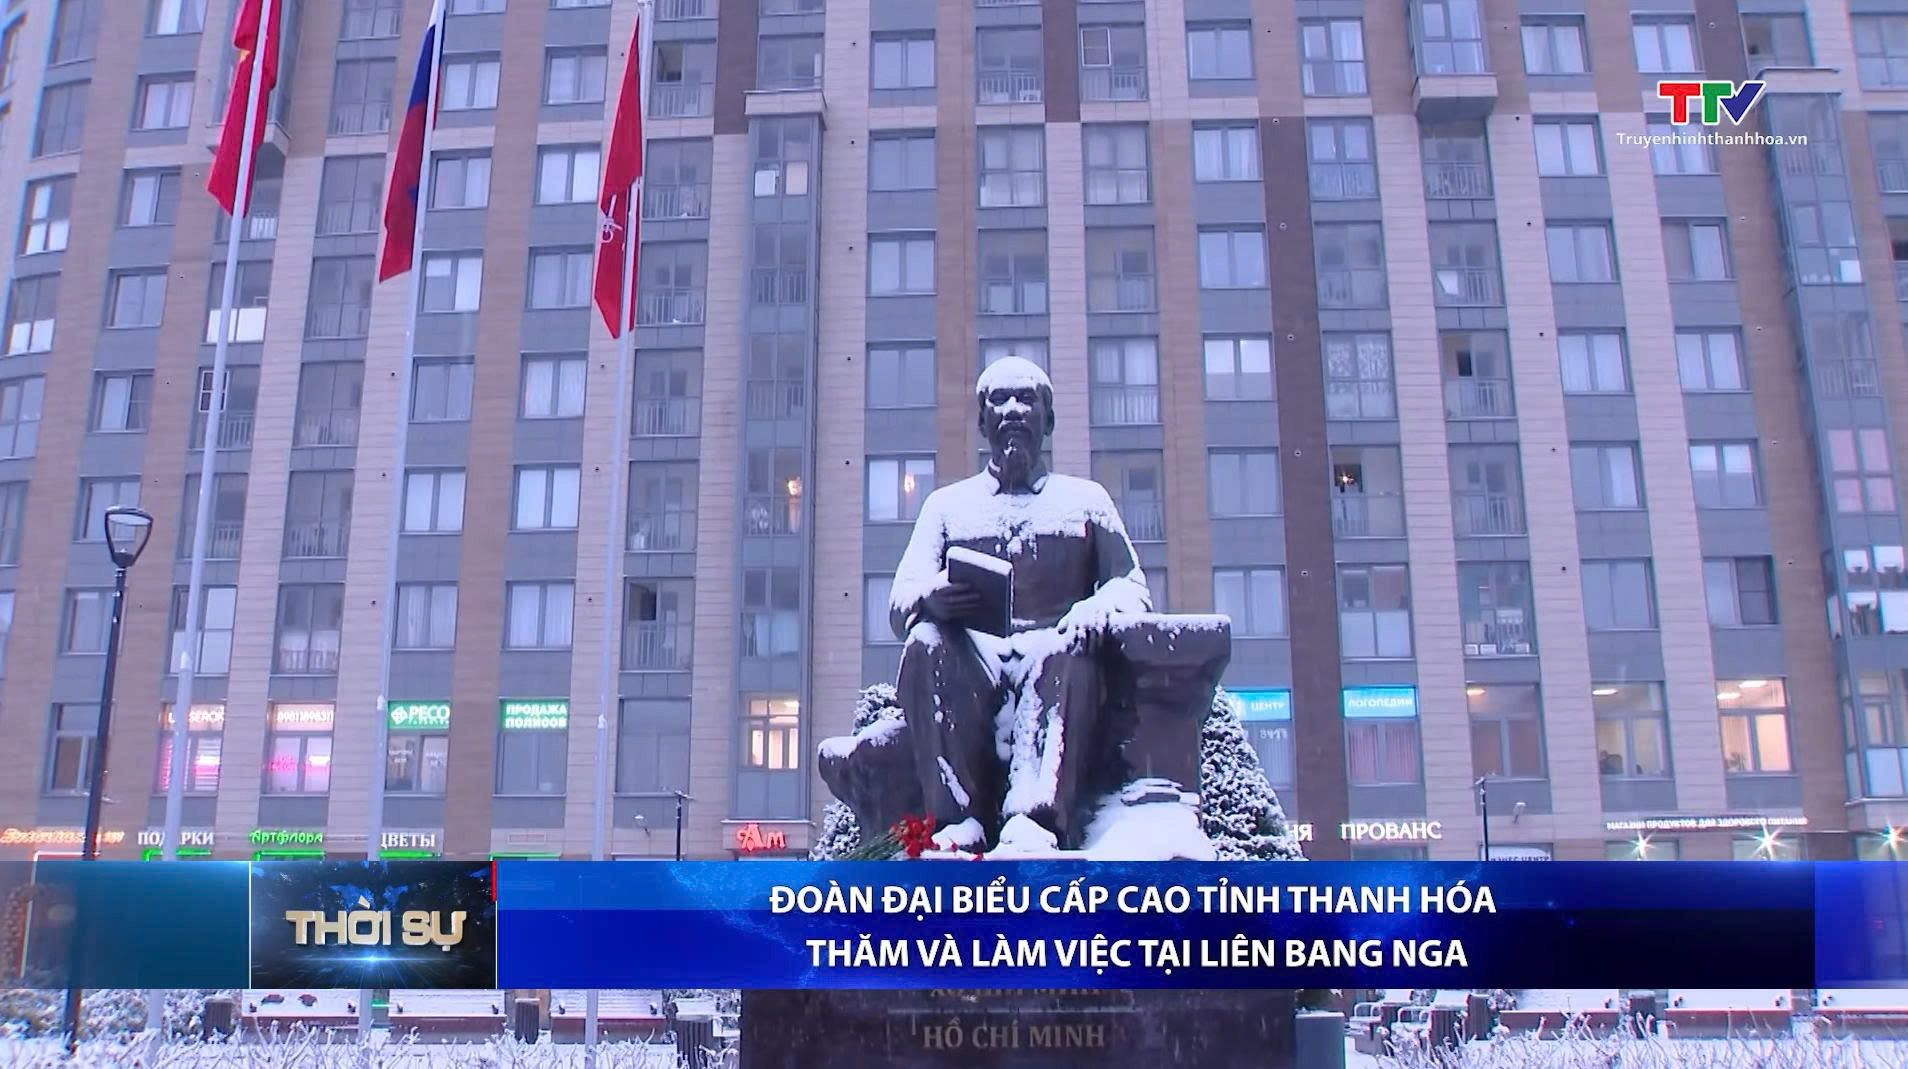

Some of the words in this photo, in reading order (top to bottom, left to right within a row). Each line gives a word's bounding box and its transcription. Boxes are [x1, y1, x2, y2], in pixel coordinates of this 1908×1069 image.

[408, 705, 450, 720] РЕСО
[506, 704, 567, 716] ПРОДАЖА
[505, 717, 567, 728] ПОЛИСОВ
[1341, 822, 1442, 840] ПРОВАНС
[138, 831, 214, 847] ПОРКИ
[924, 1016, 963, 1048] HỒ
[973, 1018, 1019, 1048] CHÍ
[1029, 1025, 1104, 1048] MINH
